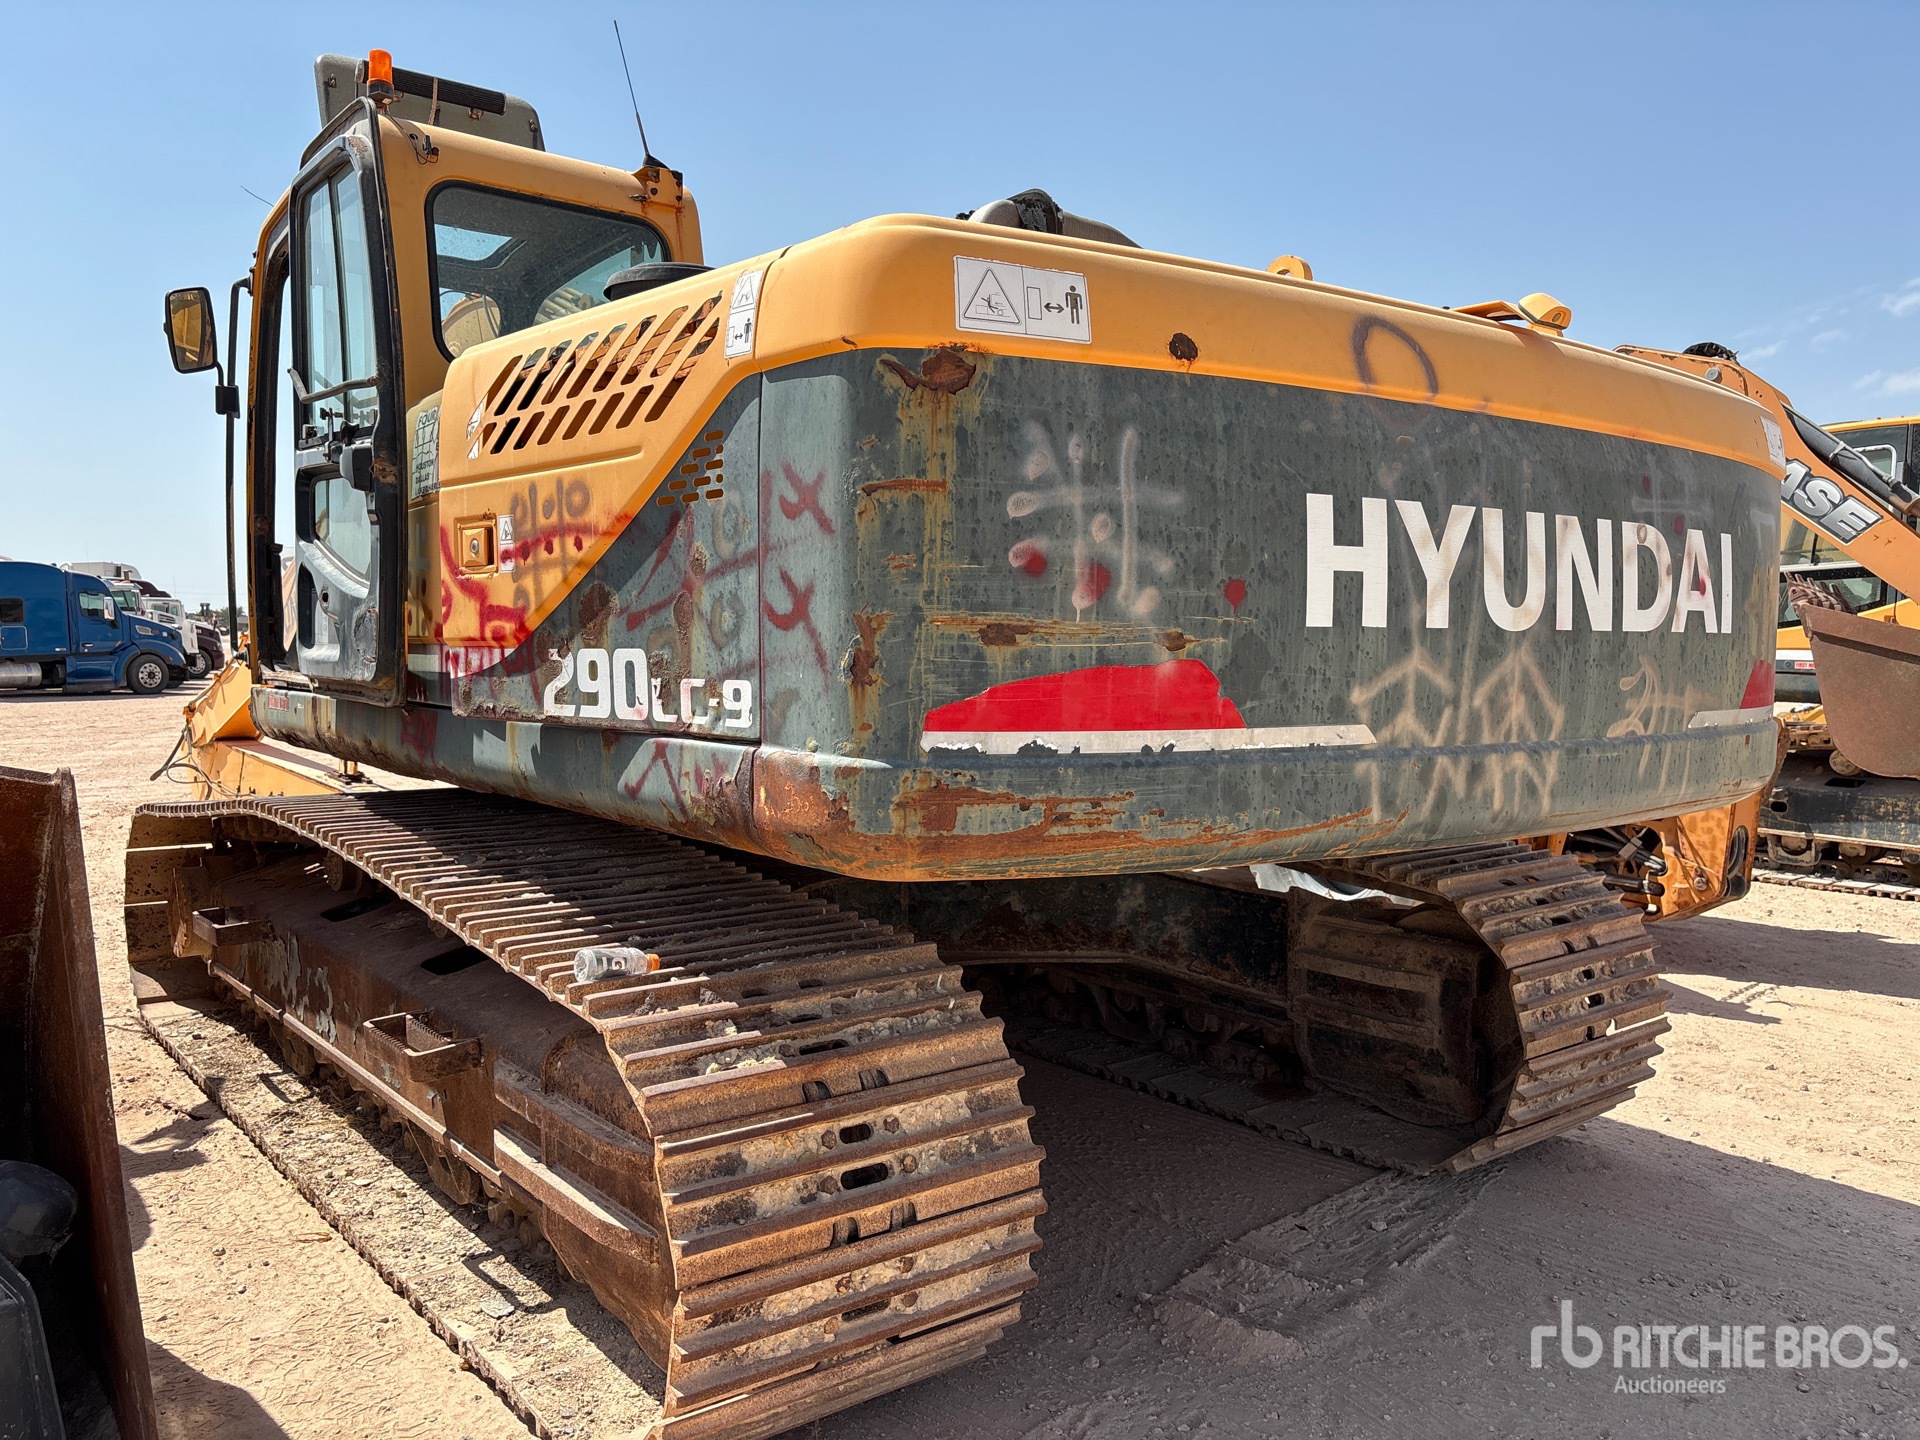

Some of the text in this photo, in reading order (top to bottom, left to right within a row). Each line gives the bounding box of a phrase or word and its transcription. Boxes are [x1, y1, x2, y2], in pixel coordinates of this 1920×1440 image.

[1781, 459, 1883, 543] ASE
[1305, 493, 1733, 635] HYUNDAI
[543, 648, 753, 729] 290LC-9
